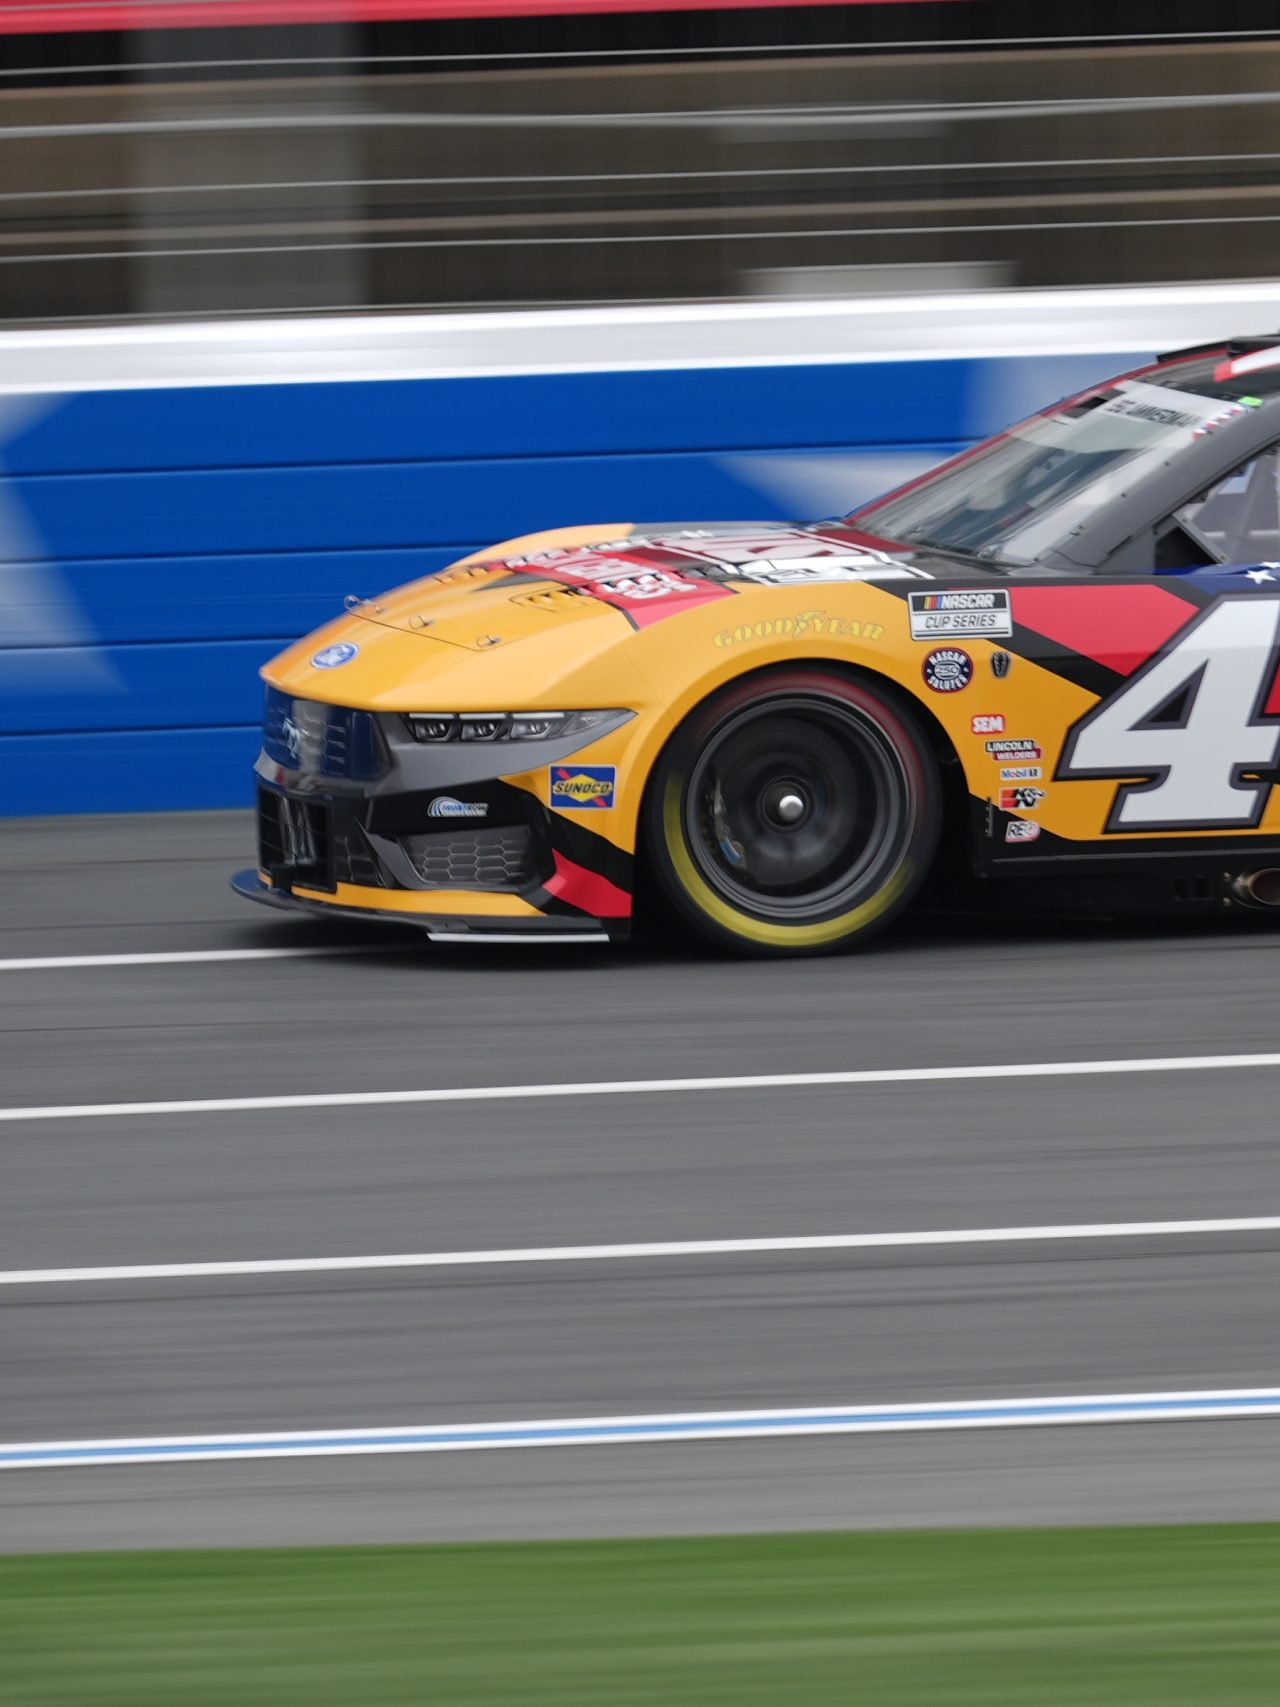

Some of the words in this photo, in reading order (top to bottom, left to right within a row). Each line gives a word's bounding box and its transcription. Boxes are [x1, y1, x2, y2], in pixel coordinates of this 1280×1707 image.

[940, 594, 995, 609] NASCAR
[925, 616, 950, 628] CUP
[952, 614, 996, 628] SERIES
[713, 616, 886, 648] GOODYEAR
[928, 651, 966, 666] NASCAR
[926, 674, 969, 691] SALUTES
[972, 716, 1004, 733] SEM
[986, 741, 1033, 752] LINCOLN
[996, 750, 1038, 760] WELDERS
[1001, 769, 1027, 778] Mobil
[554, 782, 613, 795] SUNOCO
